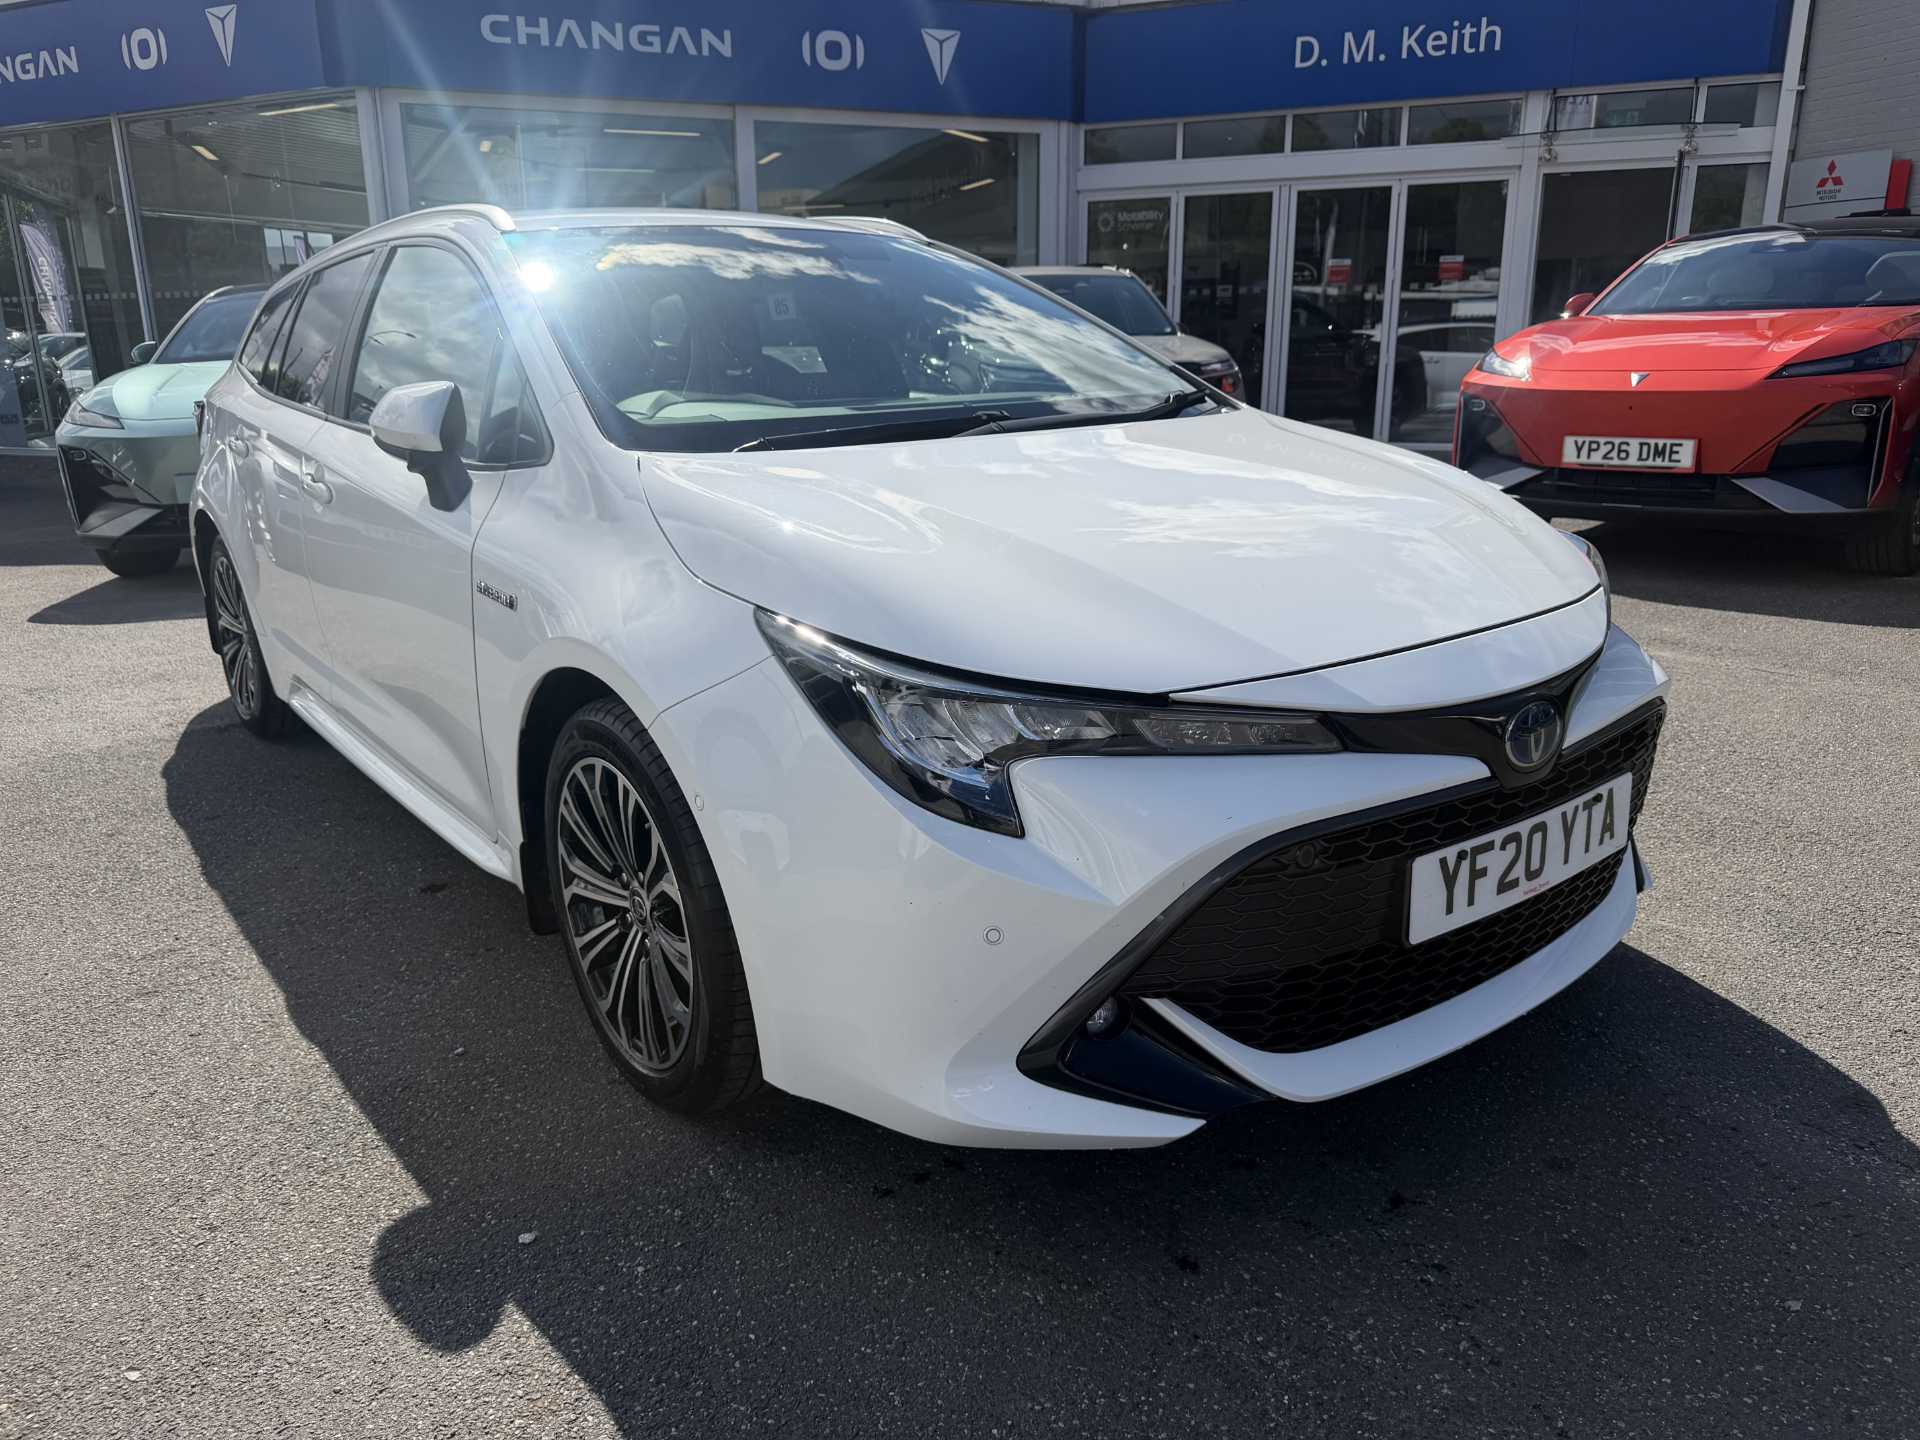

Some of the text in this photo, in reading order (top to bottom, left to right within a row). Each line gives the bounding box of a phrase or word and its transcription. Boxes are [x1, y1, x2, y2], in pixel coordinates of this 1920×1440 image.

[480, 14, 732, 57] CHANGAN
[1295, 16, 1502, 68] D. M. Keith
[1574, 440, 1683, 463] YP26 DME
[1439, 788, 1615, 916] YF20 YTA
